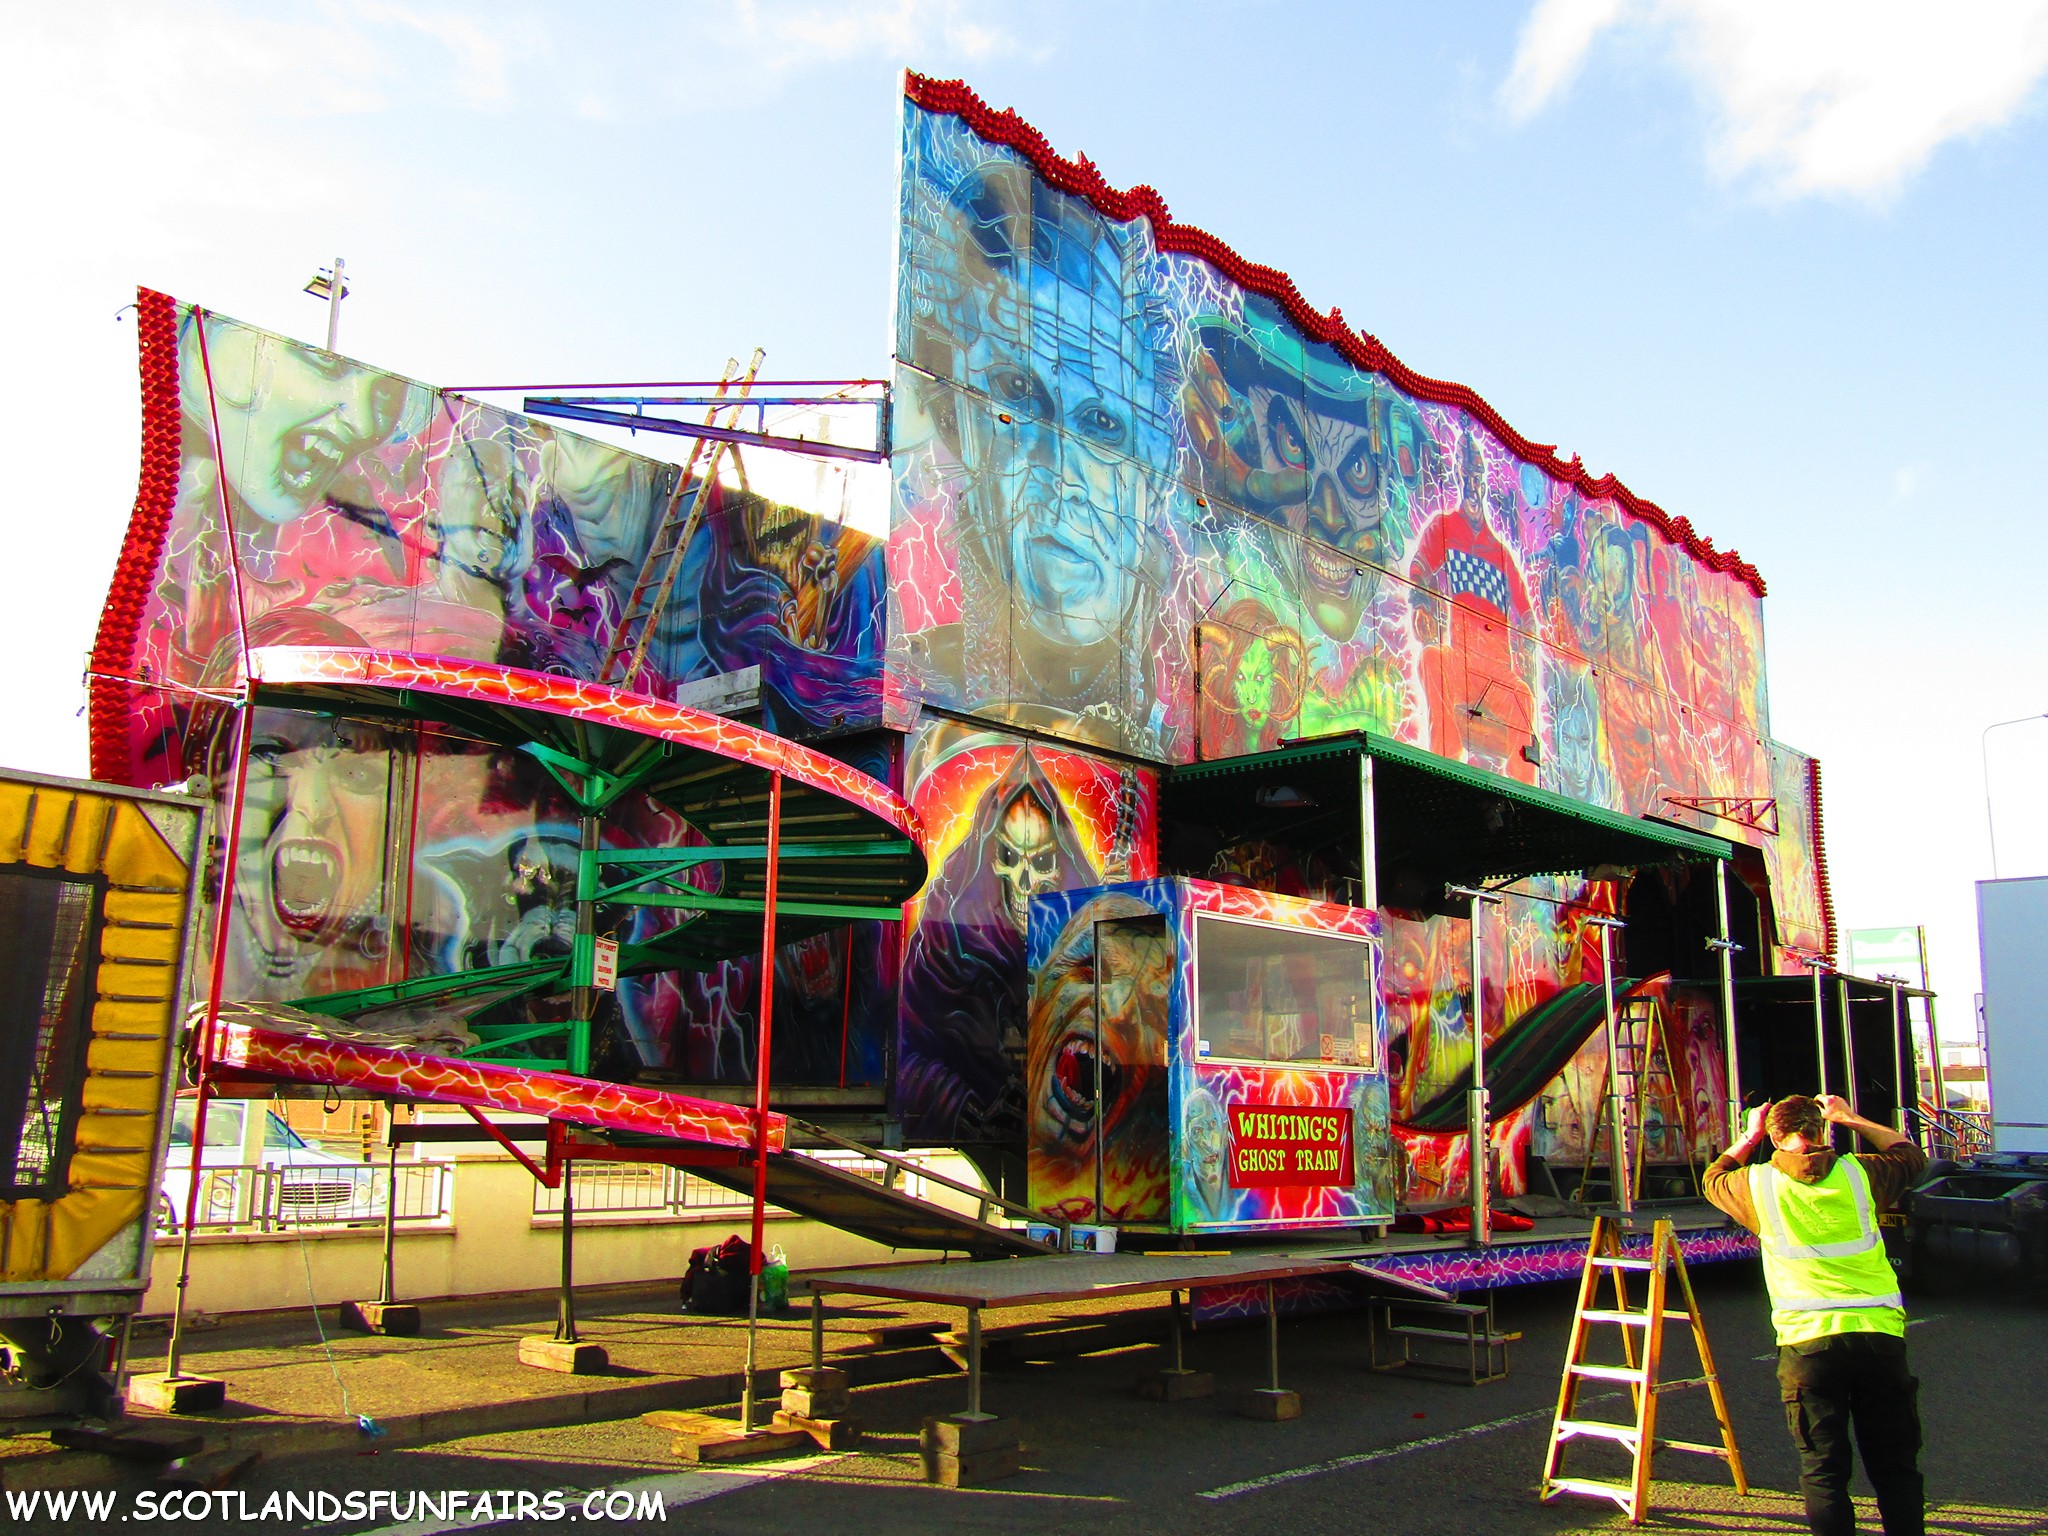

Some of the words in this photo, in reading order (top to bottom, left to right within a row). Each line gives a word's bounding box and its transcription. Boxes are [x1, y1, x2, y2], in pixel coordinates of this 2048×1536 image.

[1238, 1112, 1338, 1142] WHITING'S
[1238, 1149, 1286, 1172] GHOST
[1295, 1149, 1339, 1171] TRAIN
